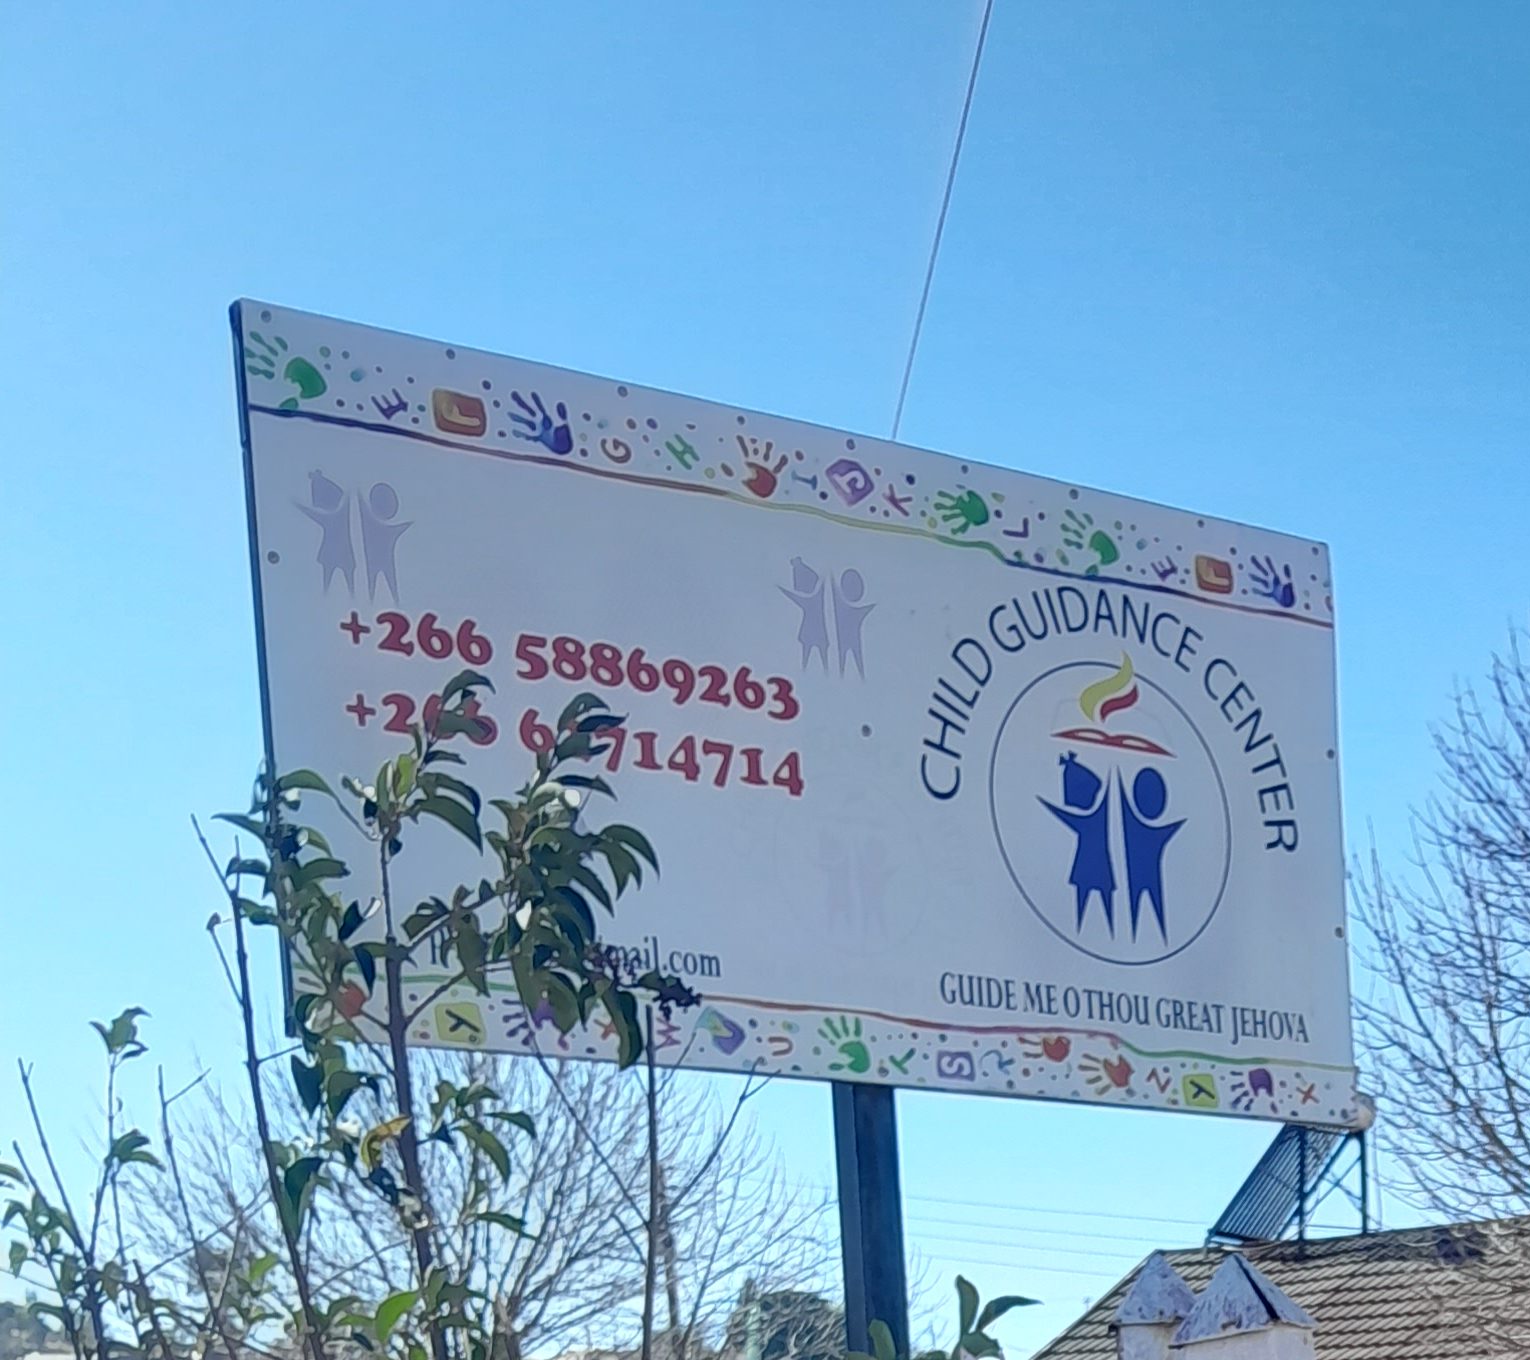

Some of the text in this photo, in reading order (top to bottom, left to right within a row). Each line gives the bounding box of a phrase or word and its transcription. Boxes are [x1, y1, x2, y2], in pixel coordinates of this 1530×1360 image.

[339, 611, 800, 721] +266 58869263
[519, 707, 804, 797] 6714714
[920, 585, 1299, 854] CHILD GUIDANCE CENTER
[939, 970, 1018, 1012] GUIDE
[1022, 981, 1059, 1016] ME
[1155, 996, 1225, 1035] GREAT
[1230, 1005, 1310, 1046] JEHOVA
